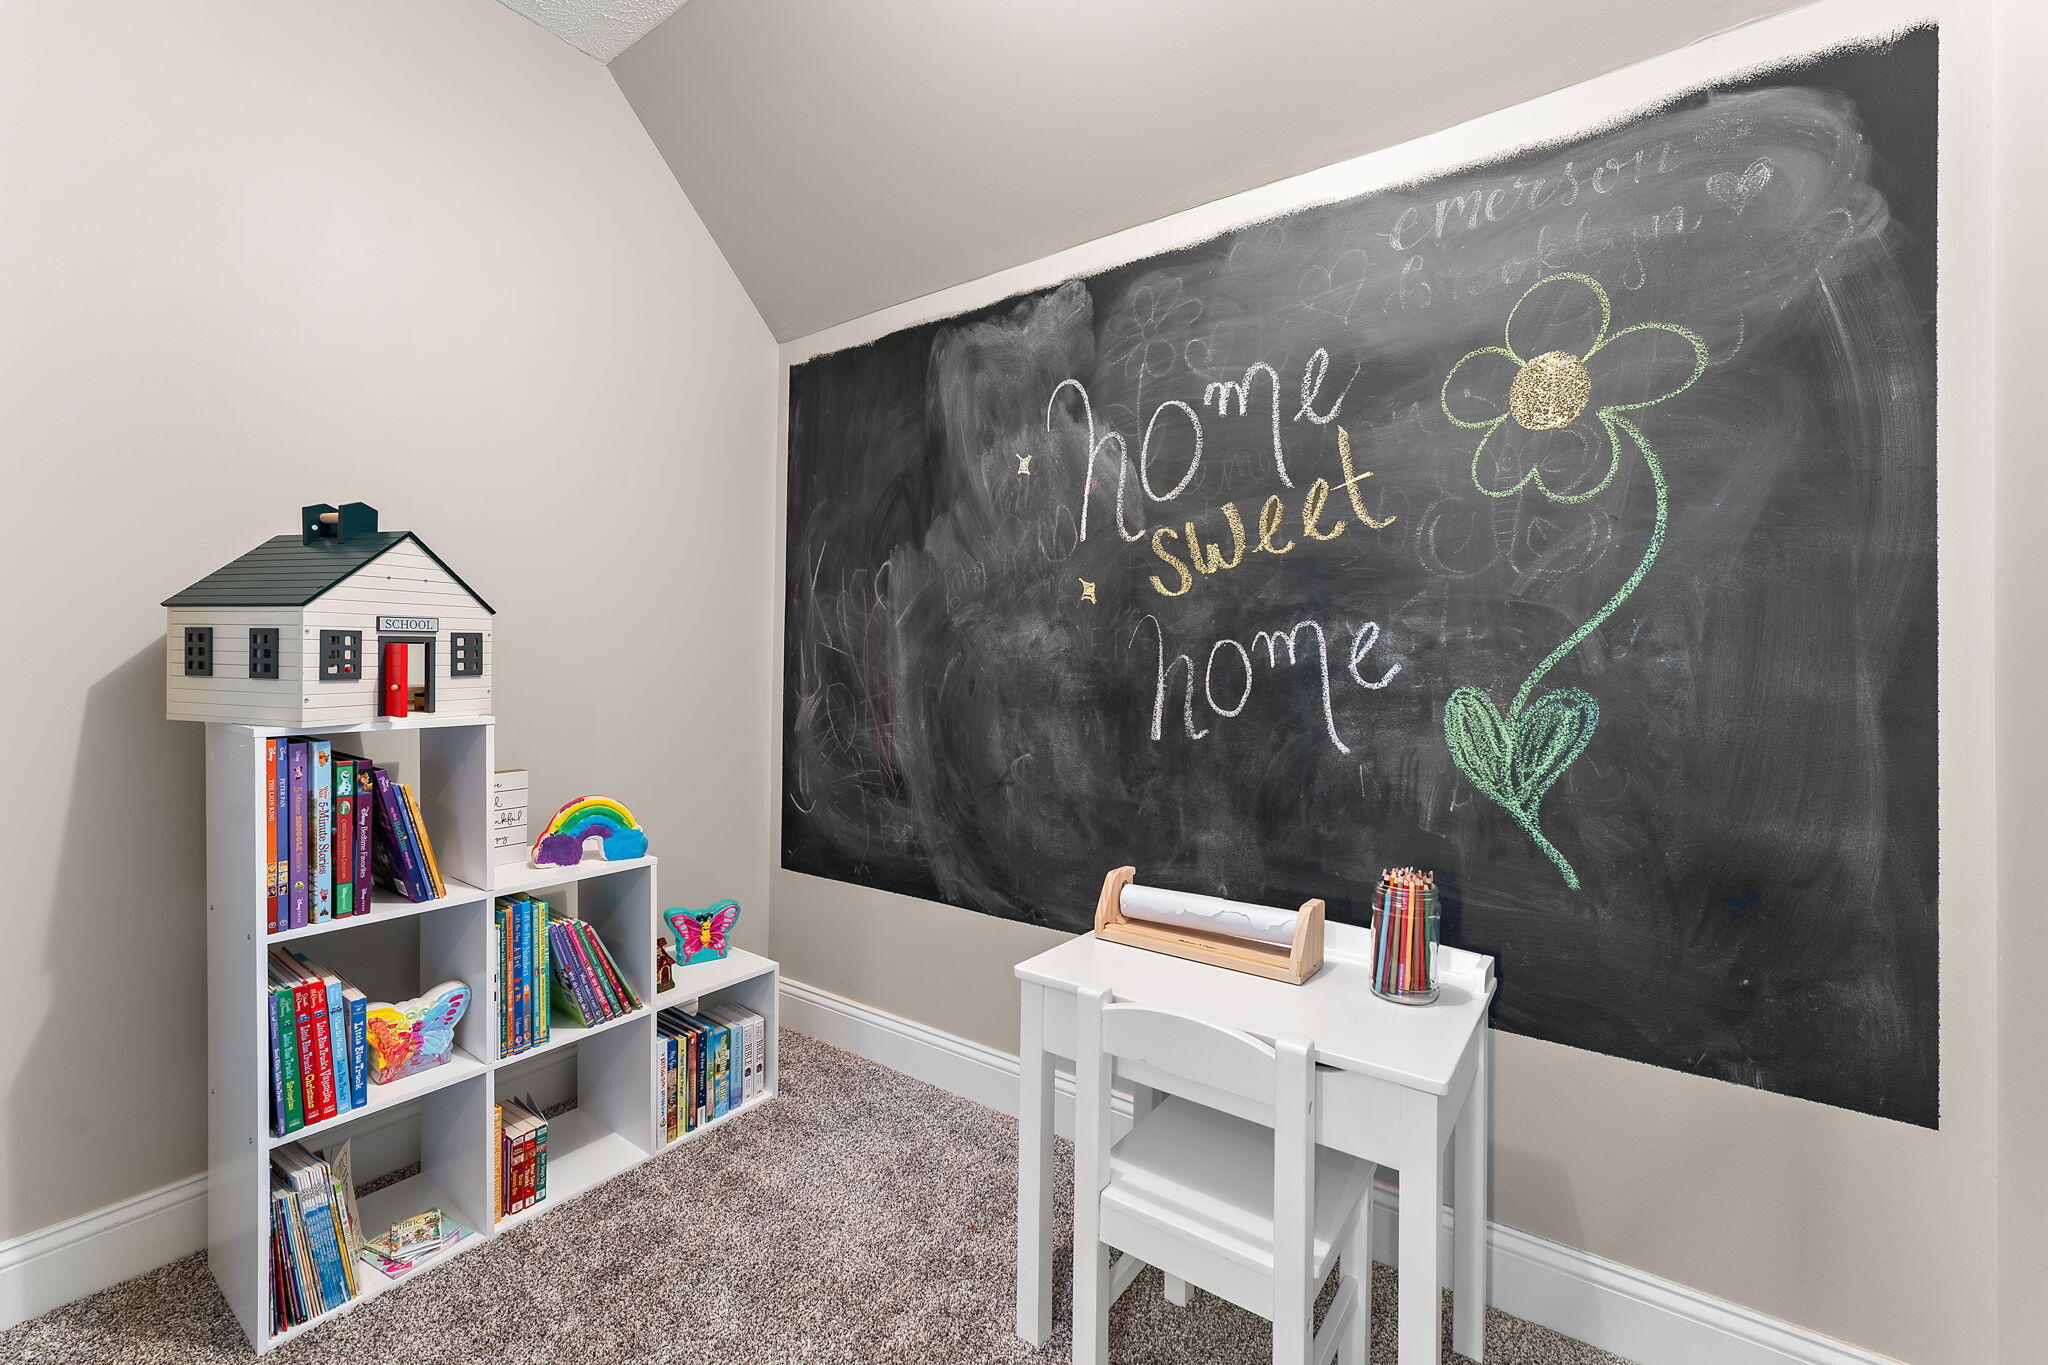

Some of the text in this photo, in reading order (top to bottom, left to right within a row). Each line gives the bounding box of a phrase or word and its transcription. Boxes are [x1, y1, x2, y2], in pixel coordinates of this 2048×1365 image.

[1047, 348, 1361, 541] home
[1149, 424, 1397, 596] sweet
[385, 619, 433, 630] SCHOOL
[1128, 614, 1402, 755] home
[318, 802, 330, 874] 5-Minute Stories
[360, 826, 368, 851] Bedtime
[393, 821, 408, 852] Bedtime
[360, 852, 368, 878] Favorites
[522, 946, 531, 977] Numbers
[587, 966, 595, 978] What
[568, 971, 576, 981] Why
[574, 988, 584, 1003] things
[579, 973, 587, 984] What
[283, 1032, 293, 1047] Little
[300, 1025, 311, 1040] Little
[316, 1021, 326, 1036] Little
[354, 1022, 363, 1045] Little
[284, 1047, 293, 1059] Blue
[302, 1040, 312, 1053] Blue
[317, 1037, 327, 1049] Blue
[355, 1046, 363, 1063] Blue
[744, 1044, 752, 1066] BIBLE
[319, 1070, 332, 1103] Valentine
[355, 1063, 364, 1090] Truck
[286, 1081, 295, 1111] Springtime
[303, 1074, 316, 1109] Christmas
